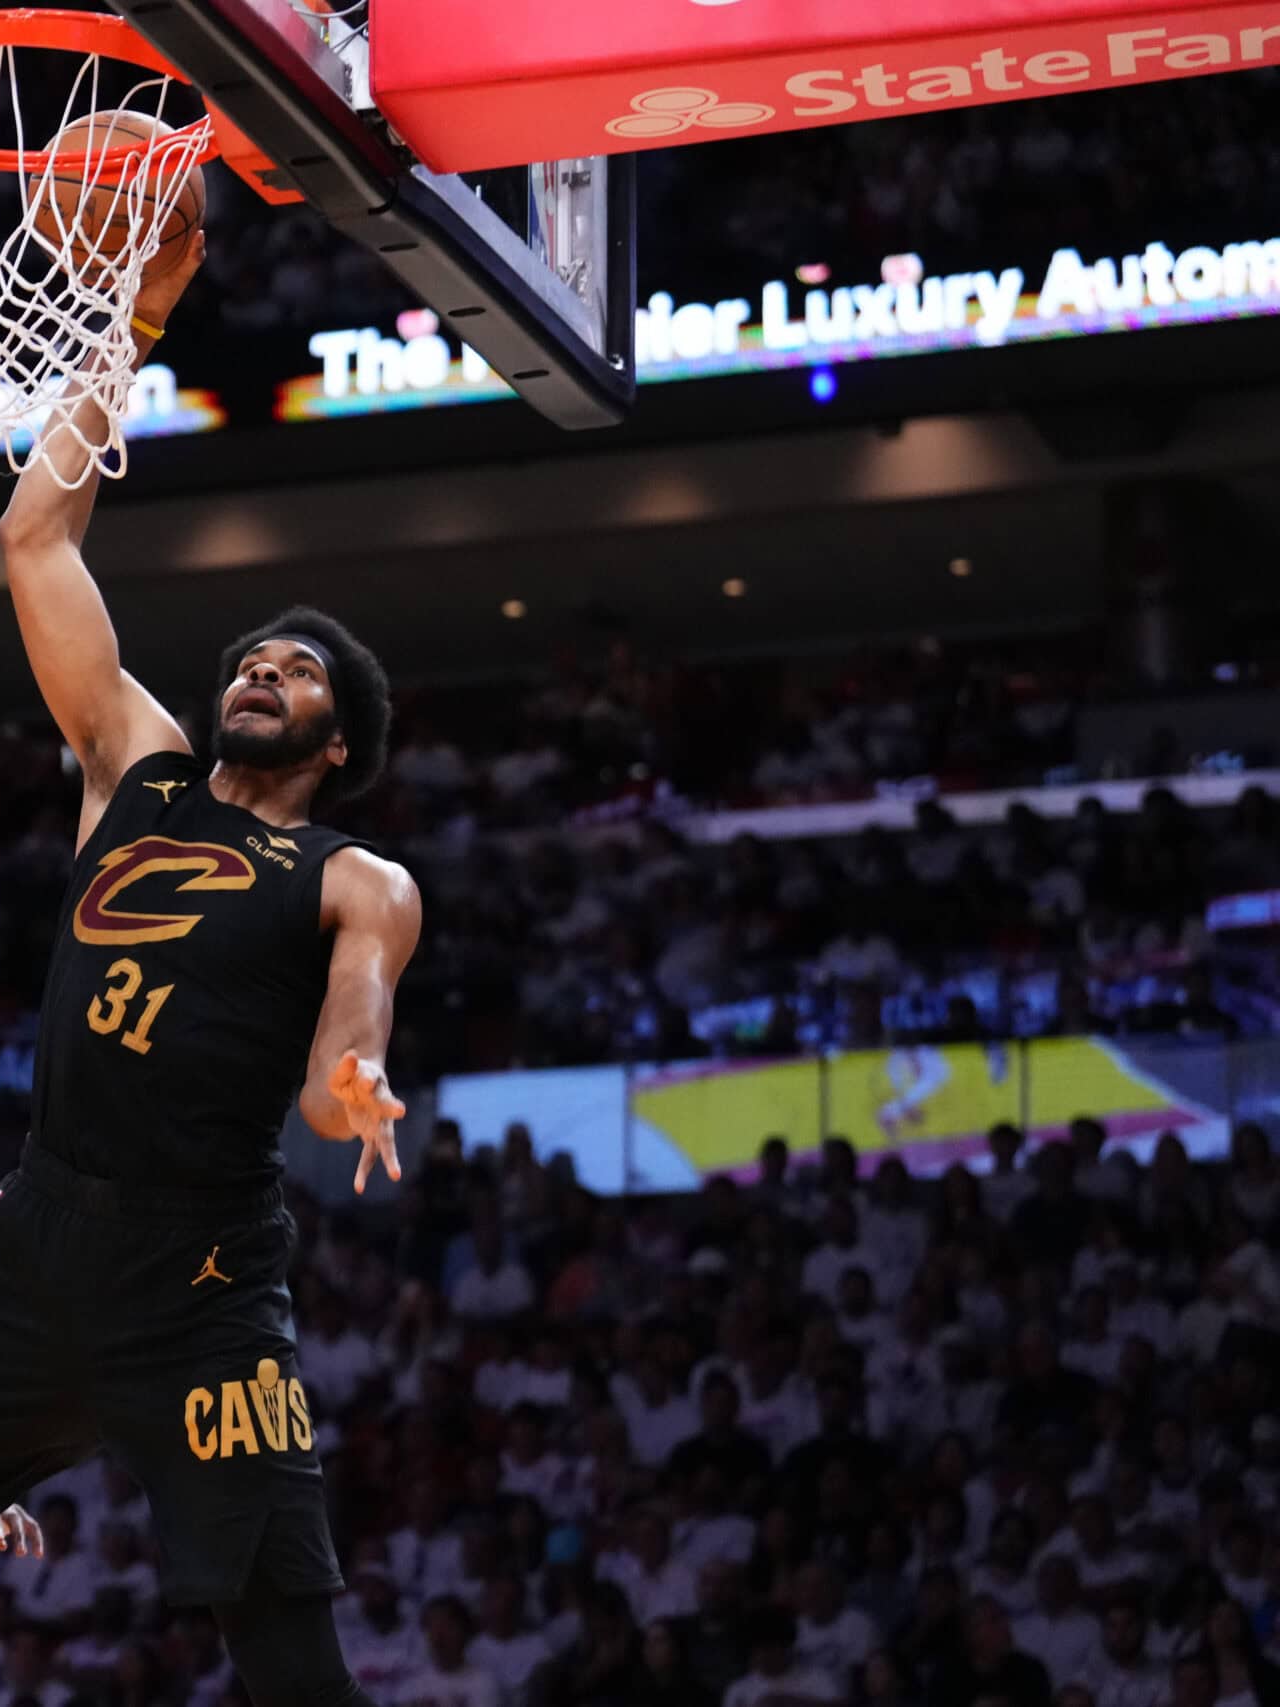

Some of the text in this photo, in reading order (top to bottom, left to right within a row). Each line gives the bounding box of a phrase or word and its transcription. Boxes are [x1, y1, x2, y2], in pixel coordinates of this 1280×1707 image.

[784, 47, 1091, 117] State
[309, 327, 451, 397] The
[762, 268, 1023, 347] Luxury
[246, 836, 295, 870] CLIFFS
[86, 957, 175, 1055] 31
[184, 1371, 313, 1461] CAVS
